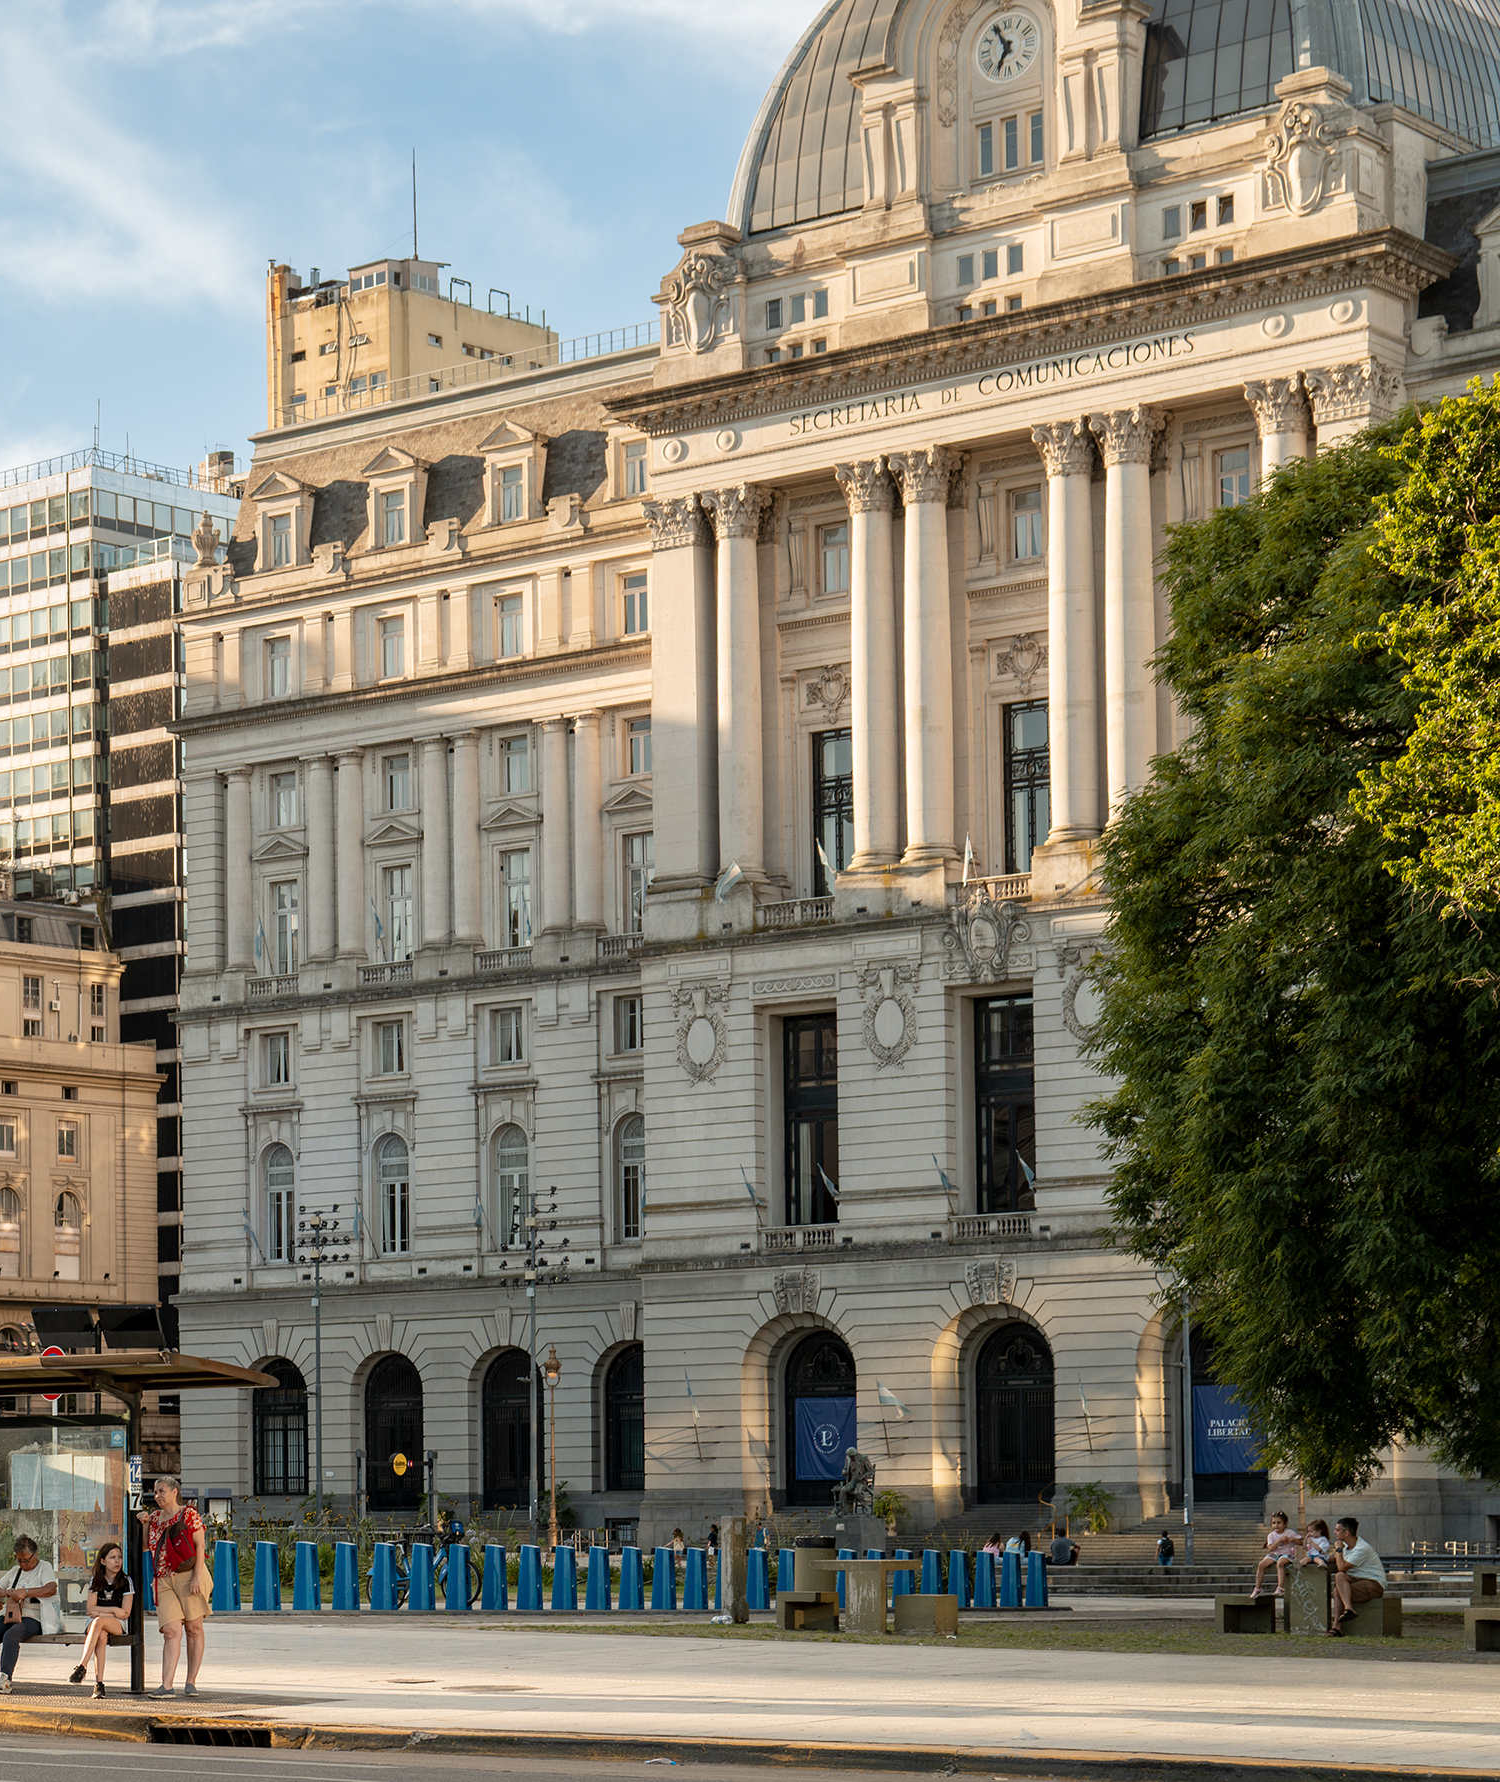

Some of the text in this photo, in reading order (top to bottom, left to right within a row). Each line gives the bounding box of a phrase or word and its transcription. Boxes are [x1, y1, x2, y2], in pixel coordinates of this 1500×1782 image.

[789, 332, 1195, 436] SECRETARIA DE COMUNICACIONES
[1210, 1418, 1249, 1428] PALACIO
